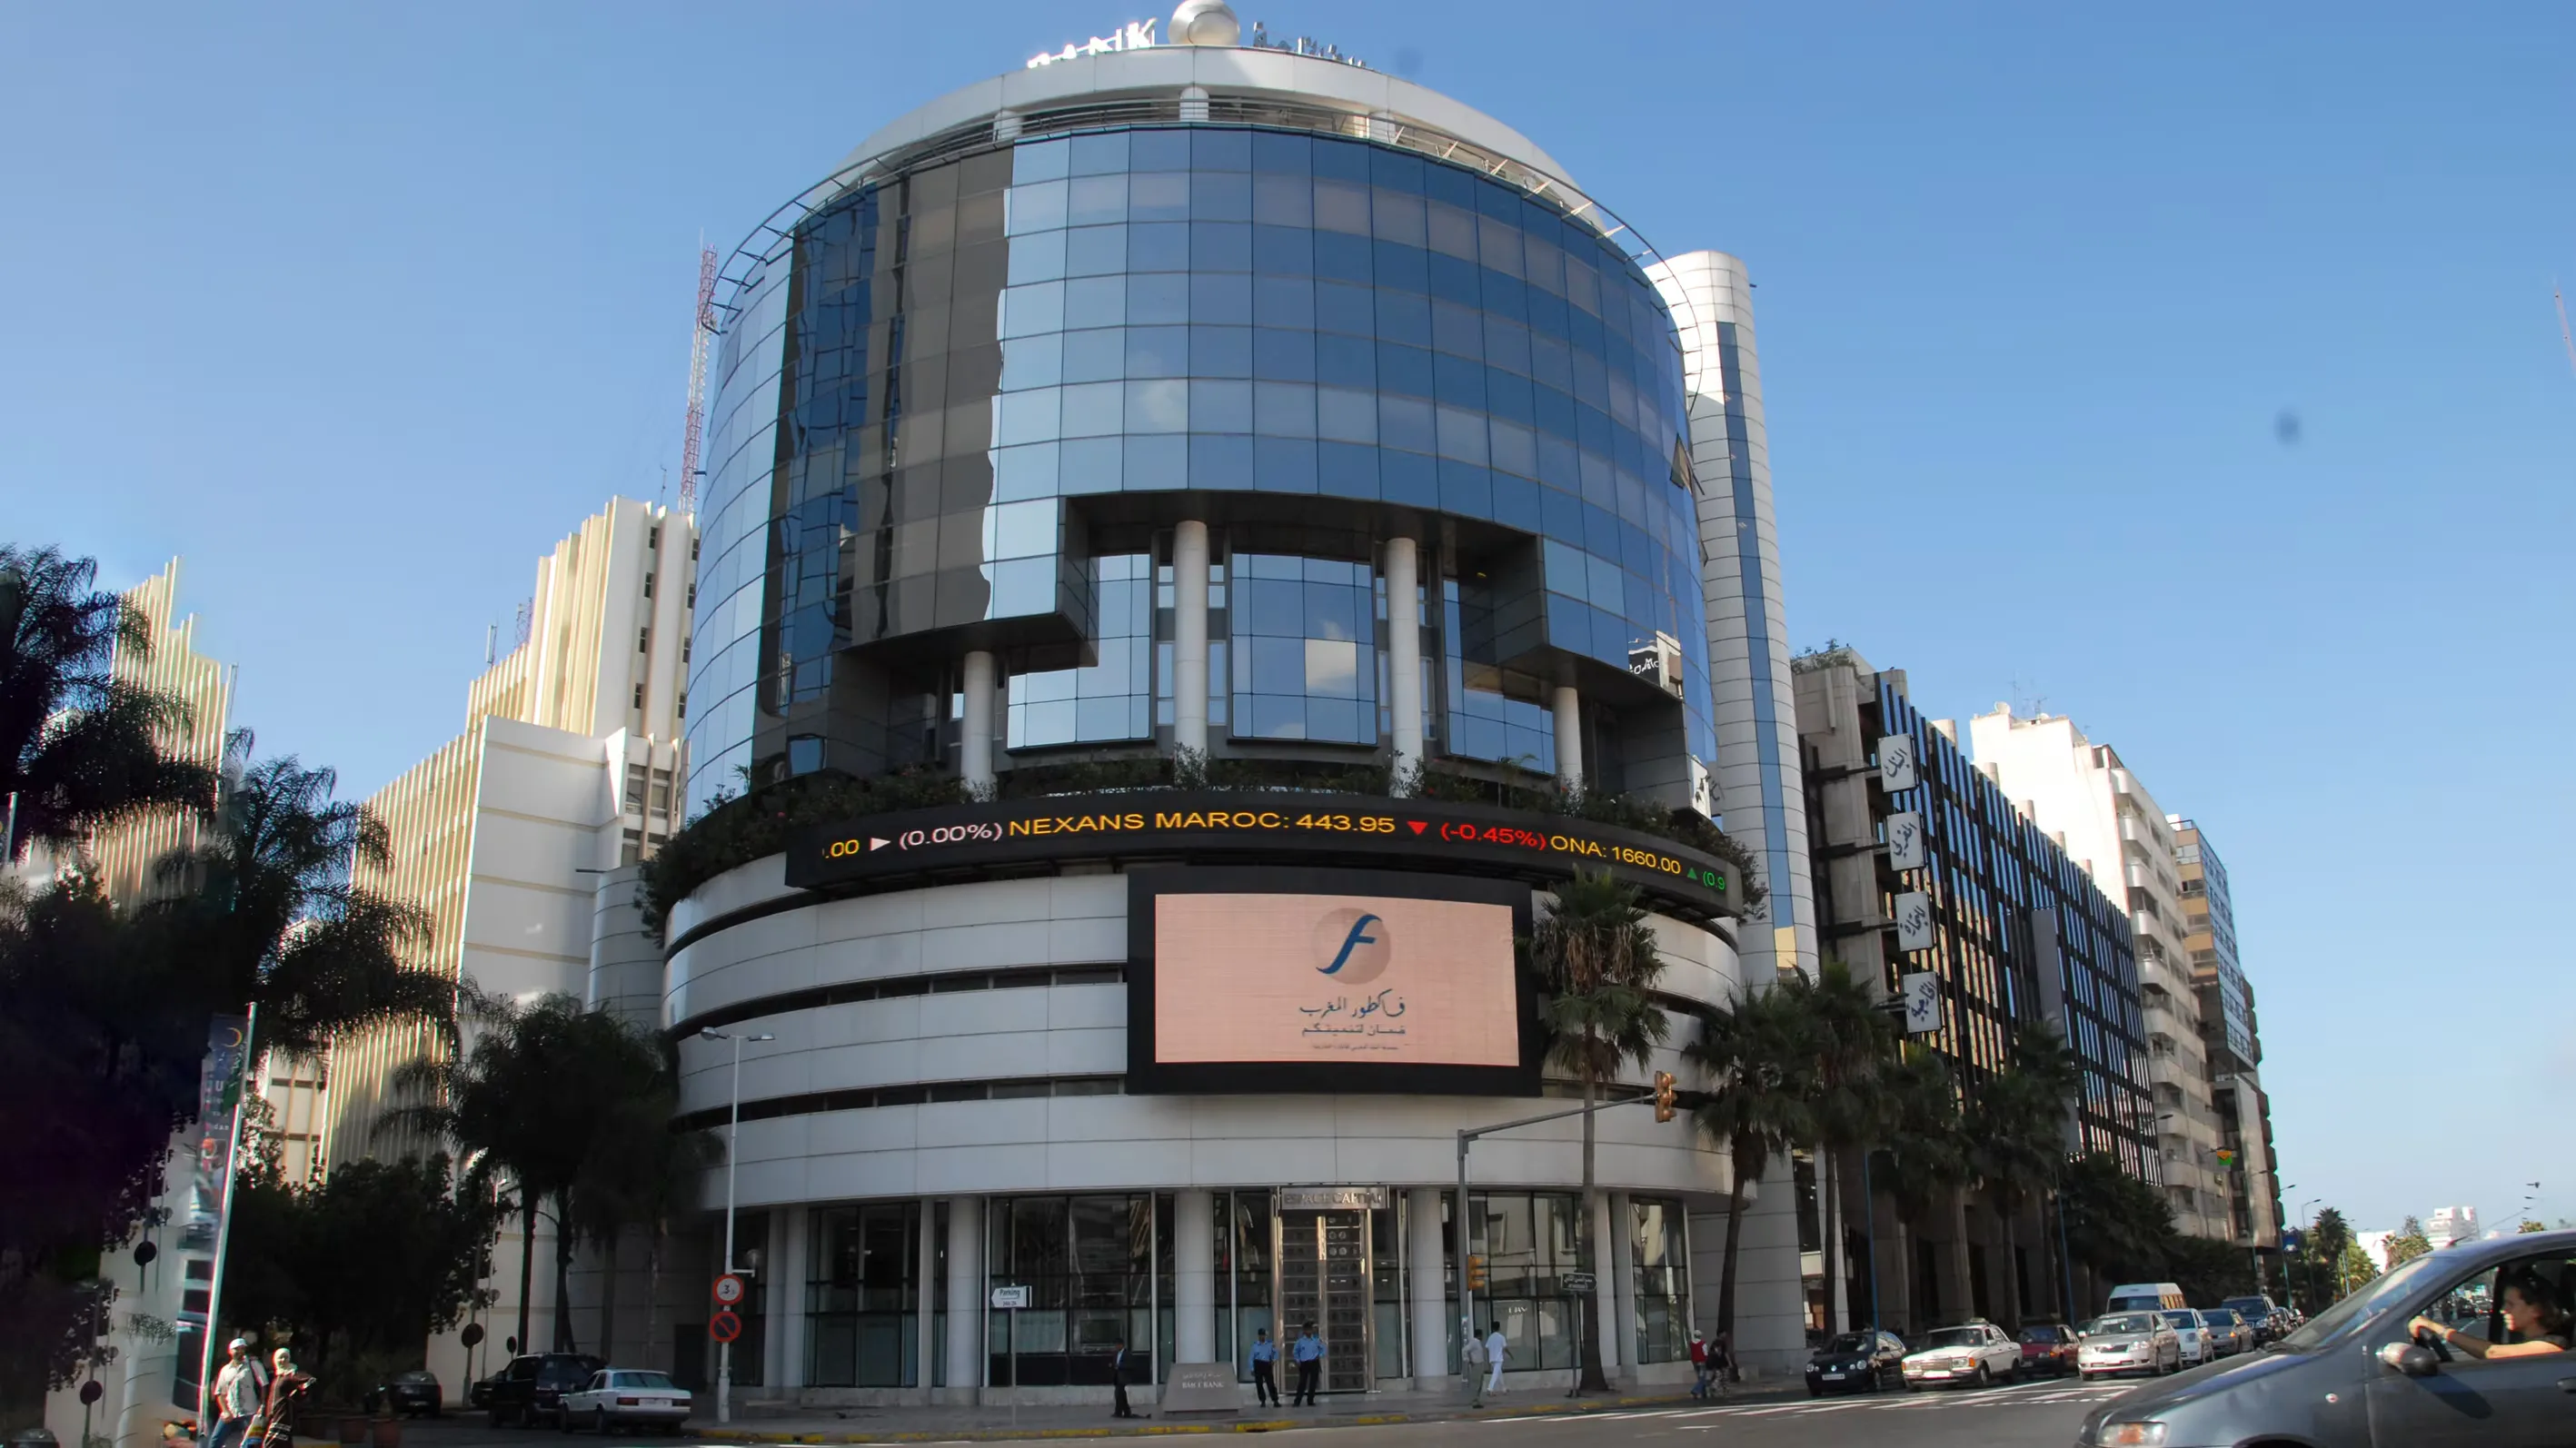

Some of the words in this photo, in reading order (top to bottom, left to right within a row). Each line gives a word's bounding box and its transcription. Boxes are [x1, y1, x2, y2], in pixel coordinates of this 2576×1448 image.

[821, 839, 860, 858] .00
[899, 823, 1003, 850] (0.00%)
[1010, 814, 1145, 836] NEXANS
[1155, 811, 1289, 828] MAROC:
[1296, 814, 1396, 833] 443.95
[1441, 822, 1547, 851] (-0.45%)
[1551, 835, 1607, 858] ONA:
[1612, 846, 1682, 875] 1660.00
[1000, 1288, 1020, 1298] Parking
